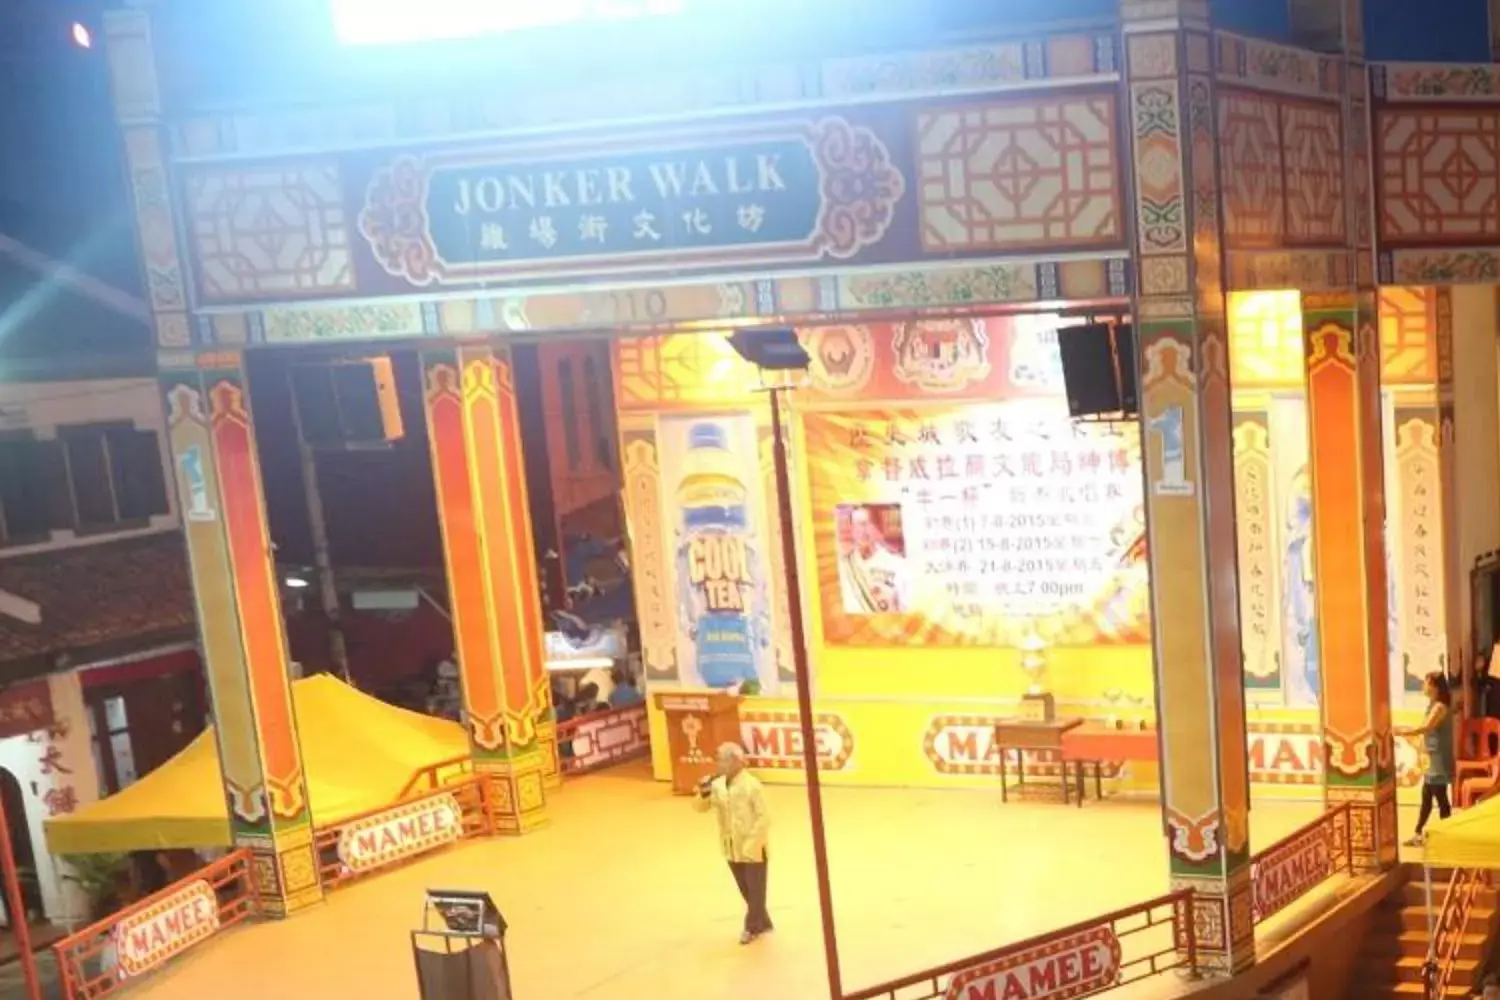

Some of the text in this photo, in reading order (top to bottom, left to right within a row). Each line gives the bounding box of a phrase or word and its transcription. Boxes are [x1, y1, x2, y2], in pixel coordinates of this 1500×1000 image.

[454, 154, 786, 215] JONKER WALK
[357, 807, 448, 855] MAMEE
[1264, 843, 1323, 898] MAMEE
[131, 897, 205, 953] MAMEE
